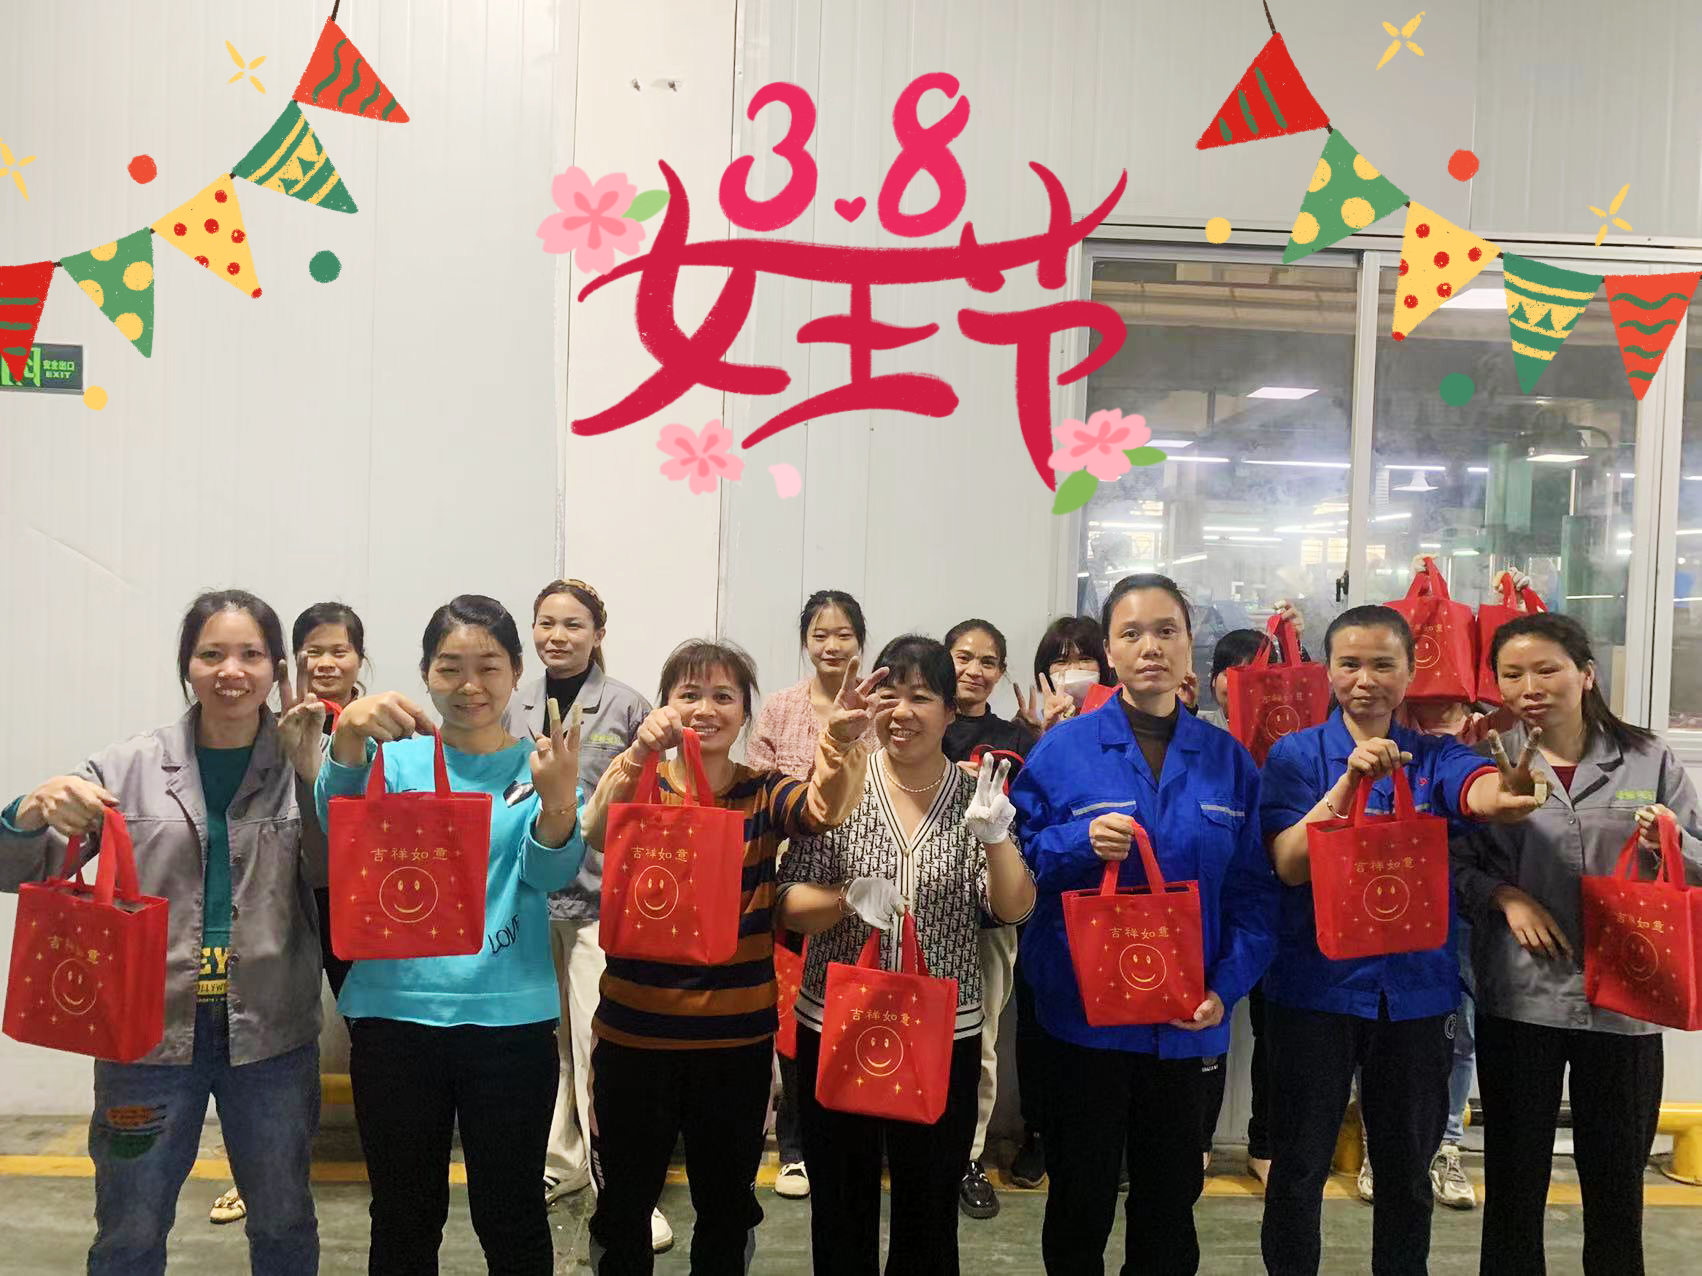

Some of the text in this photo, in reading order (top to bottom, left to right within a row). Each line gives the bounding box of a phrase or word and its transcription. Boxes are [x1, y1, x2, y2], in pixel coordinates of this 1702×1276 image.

[43, 360, 75, 371] 安全出口
[45, 371, 71, 379] EXIT
[369, 847, 448, 863] 吉祥如意
[630, 845, 688, 863] 吉祥如意
[1615, 912, 1665, 934] 吉如意
[1109, 925, 1169, 940] 吉祥如意
[47, 934, 101, 965] 吉意
[850, 1008, 910, 1027] 吉祥如意
